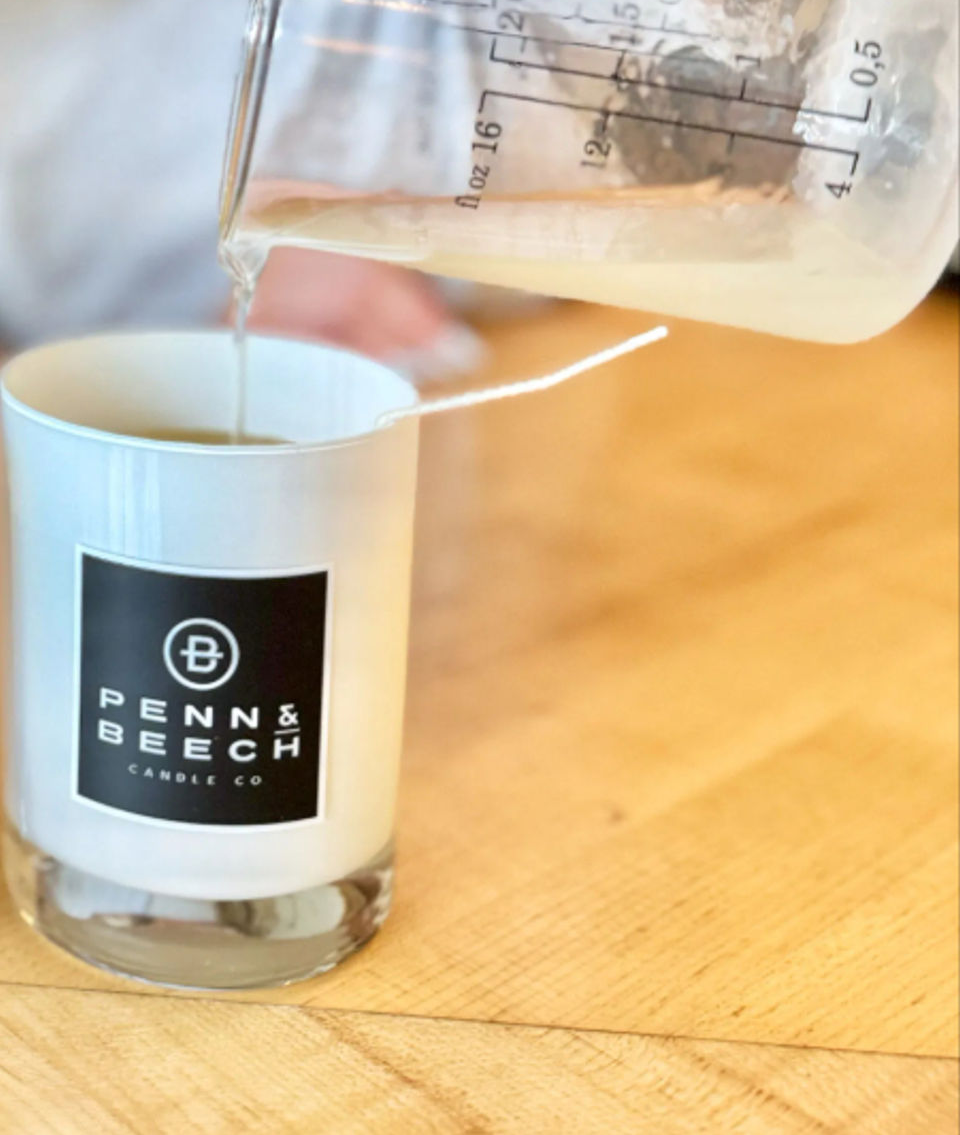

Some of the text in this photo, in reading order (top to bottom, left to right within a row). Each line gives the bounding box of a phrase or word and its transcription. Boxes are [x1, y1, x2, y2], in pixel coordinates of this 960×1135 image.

[496, 9, 524, 33] 2
[848, 39, 887, 89] 0,5
[471, 120, 503, 155] 16
[580, 139, 612, 170] 12
[468, 163, 491, 191] oz
[825, 181, 853, 200] 4
[99, 686, 300, 729] PENN &
[97, 719, 300, 763] BEECH
[128, 763, 217, 787] CANDLE
